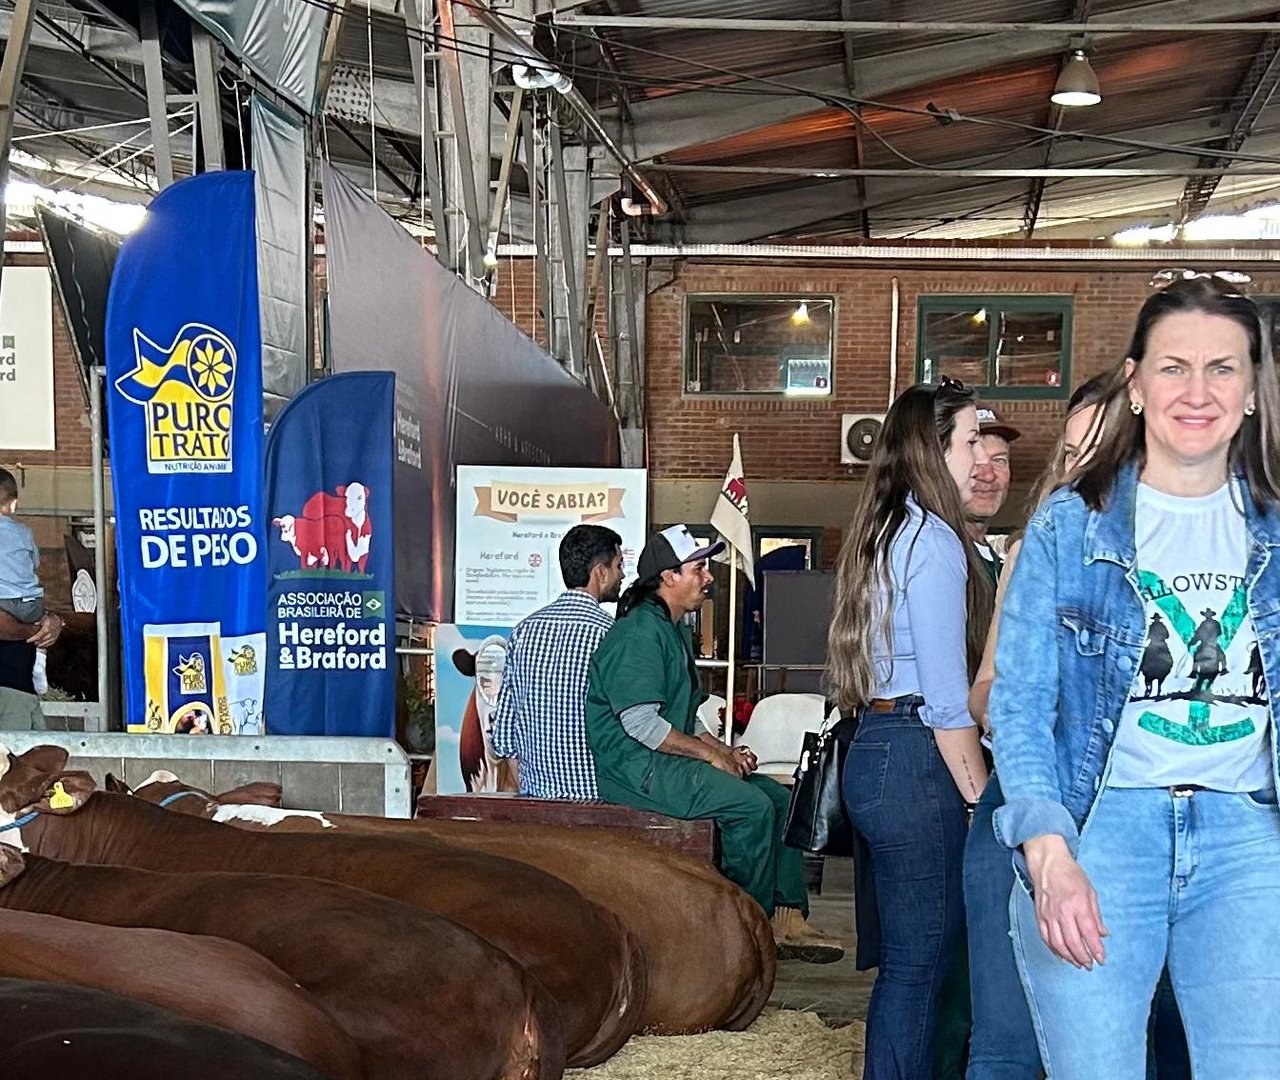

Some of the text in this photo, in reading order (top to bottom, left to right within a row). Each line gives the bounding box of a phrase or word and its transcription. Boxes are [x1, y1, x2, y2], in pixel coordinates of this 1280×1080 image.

[497, 488, 606, 510] VOCÊ SABIA?
[138, 504, 252, 531] RESULTADOS
[141, 531, 258, 569] DE PESO
[278, 591, 362, 607] ASSOCIAÇÃO
[278, 605, 362, 619] BRASILEIRA DE
[278, 622, 386, 646] Hereford
